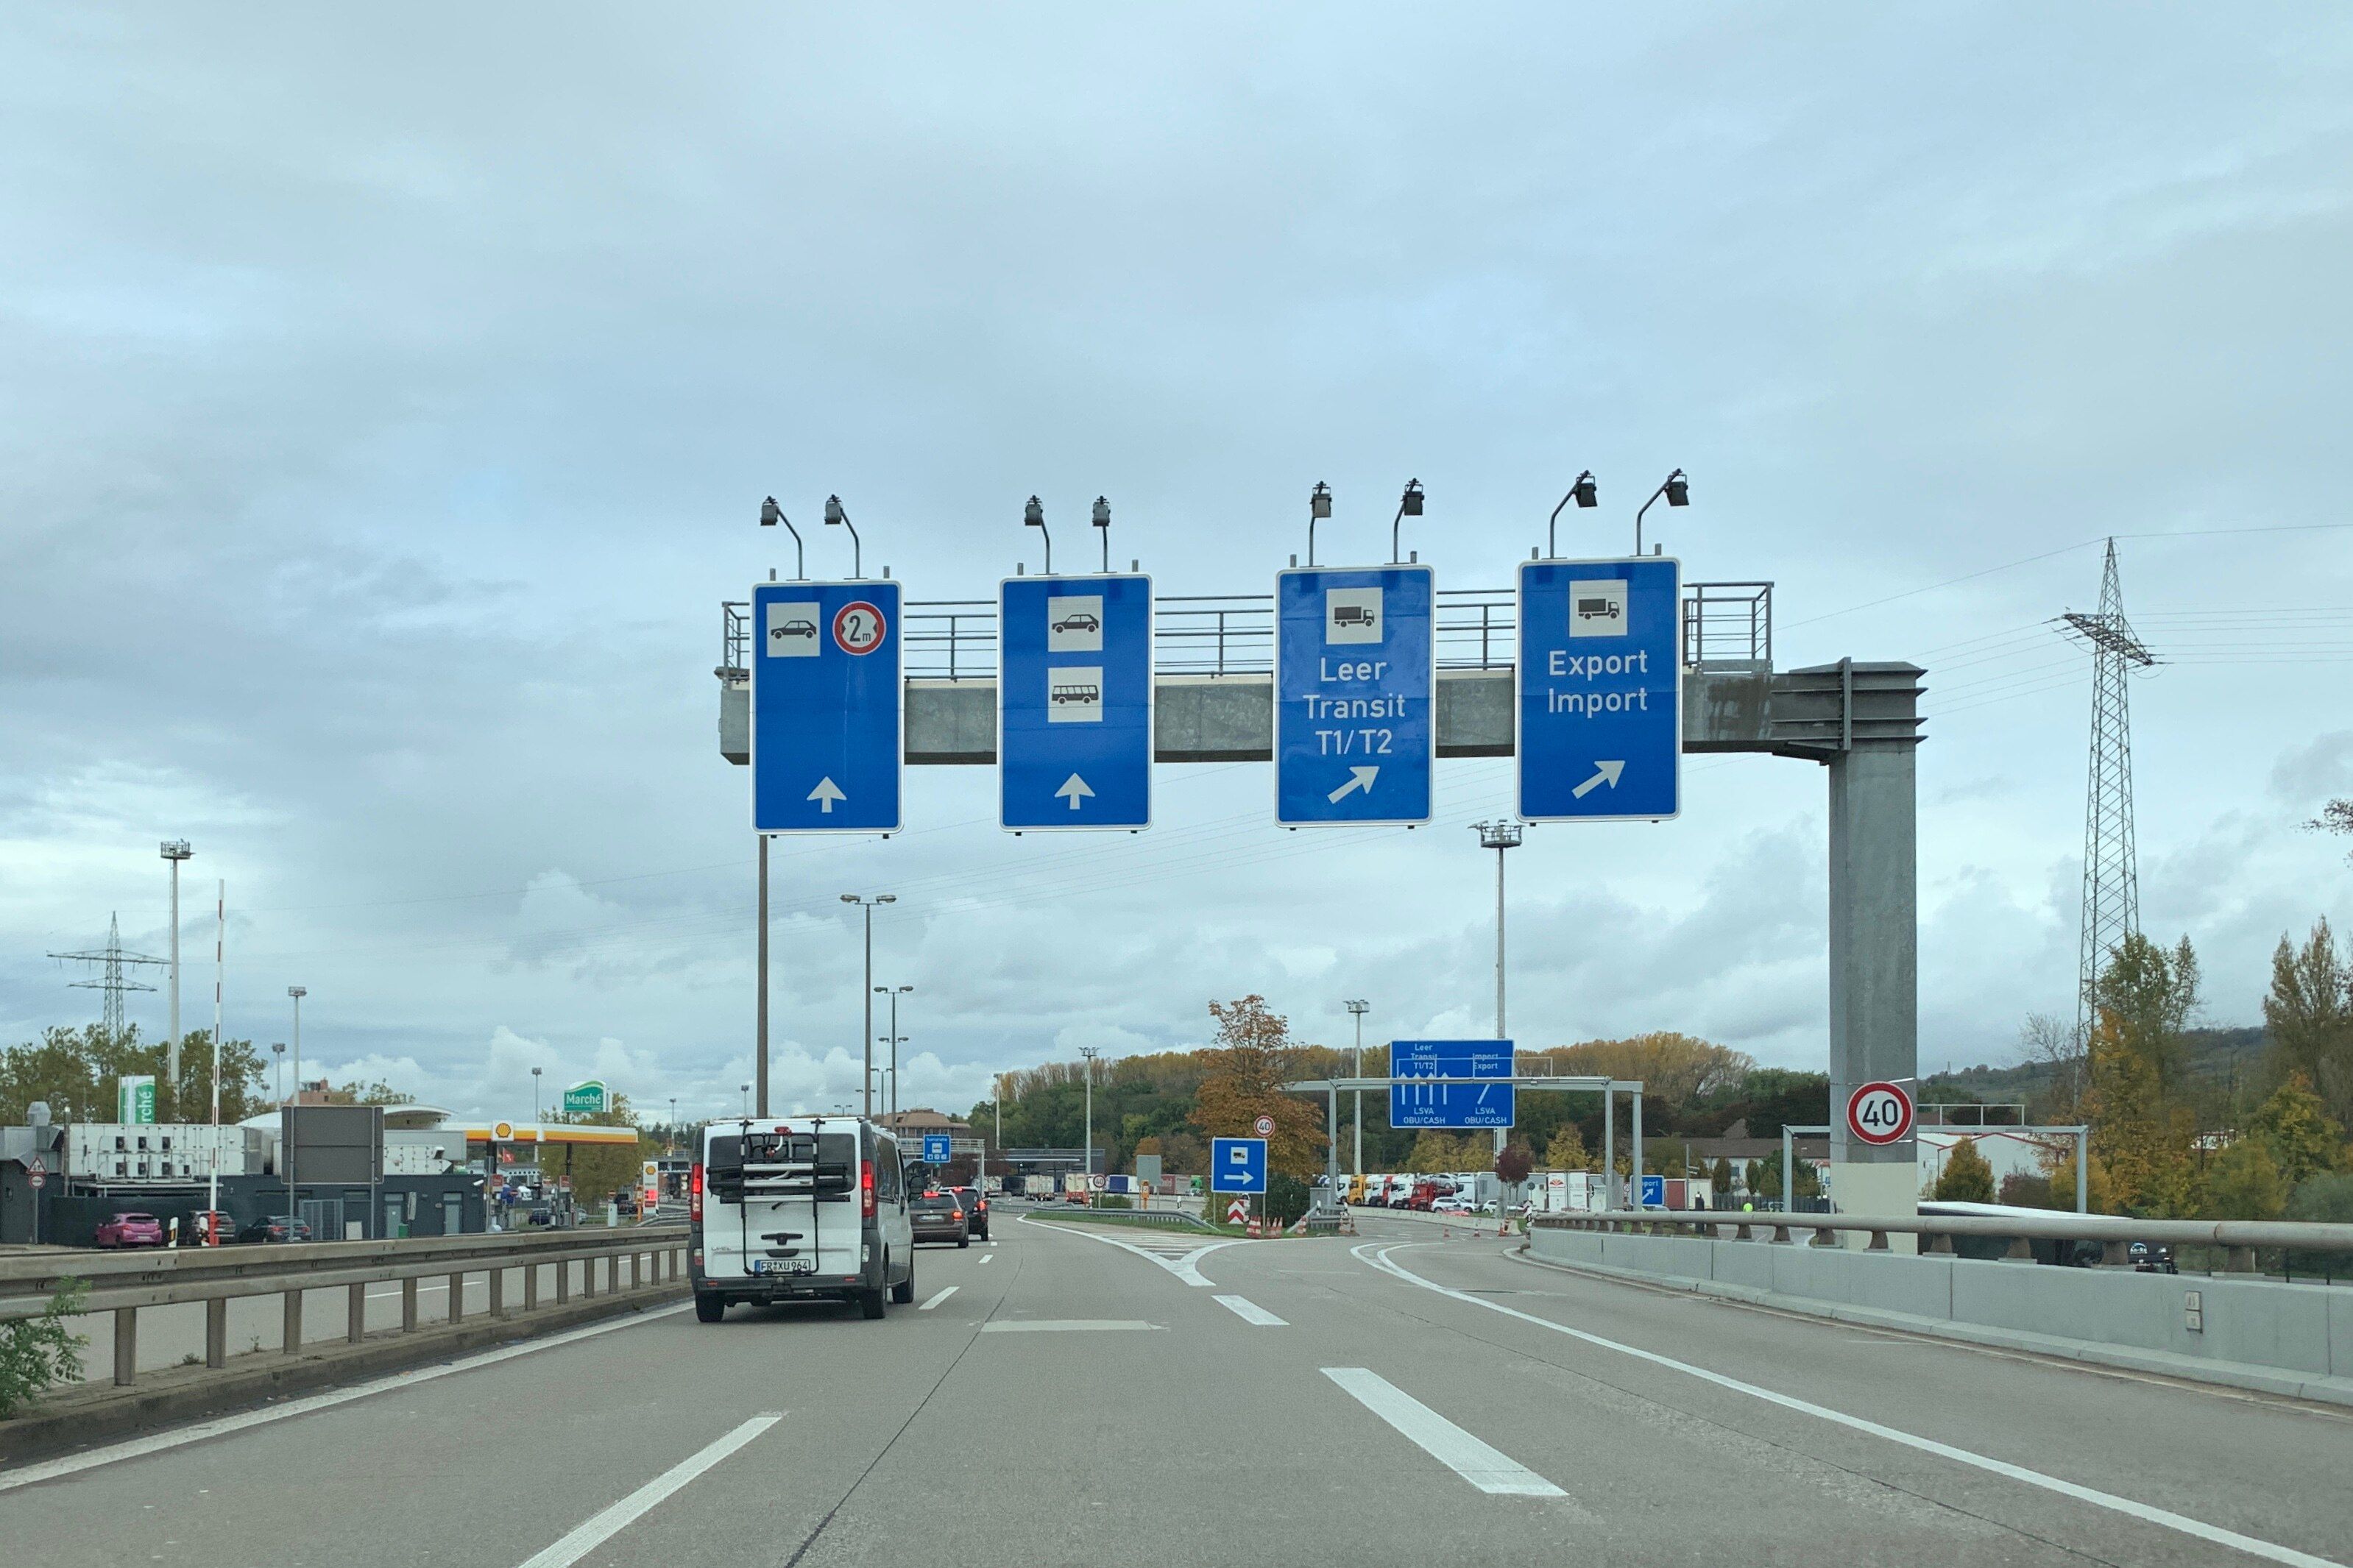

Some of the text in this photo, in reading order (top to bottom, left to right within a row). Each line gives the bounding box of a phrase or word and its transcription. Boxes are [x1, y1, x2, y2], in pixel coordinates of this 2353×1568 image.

[1320, 656, 1388, 682] Leer
[1549, 649, 1649, 681] Export
[1302, 692, 1406, 720] Transit
[1549, 687, 1649, 719] Import
[1415, 1043, 1434, 1051] Leer
[1410, 1052, 1437, 1061] Transit
[1473, 1052, 1499, 1061] Import
[1413, 1062, 1434, 1070] T1/T2
[1473, 1062, 1499, 1071] Export
[566, 1093, 601, 1104] Marché
[137, 1090, 152, 1123] rché
[1862, 1099, 1899, 1127] 40
[1403, 1116, 1446, 1125] OBU/CASH
[1464, 1116, 1508, 1125] OBU/CASH
[1259, 1121, 1271, 1131] 40
[791, 1262, 808, 1270] 964
